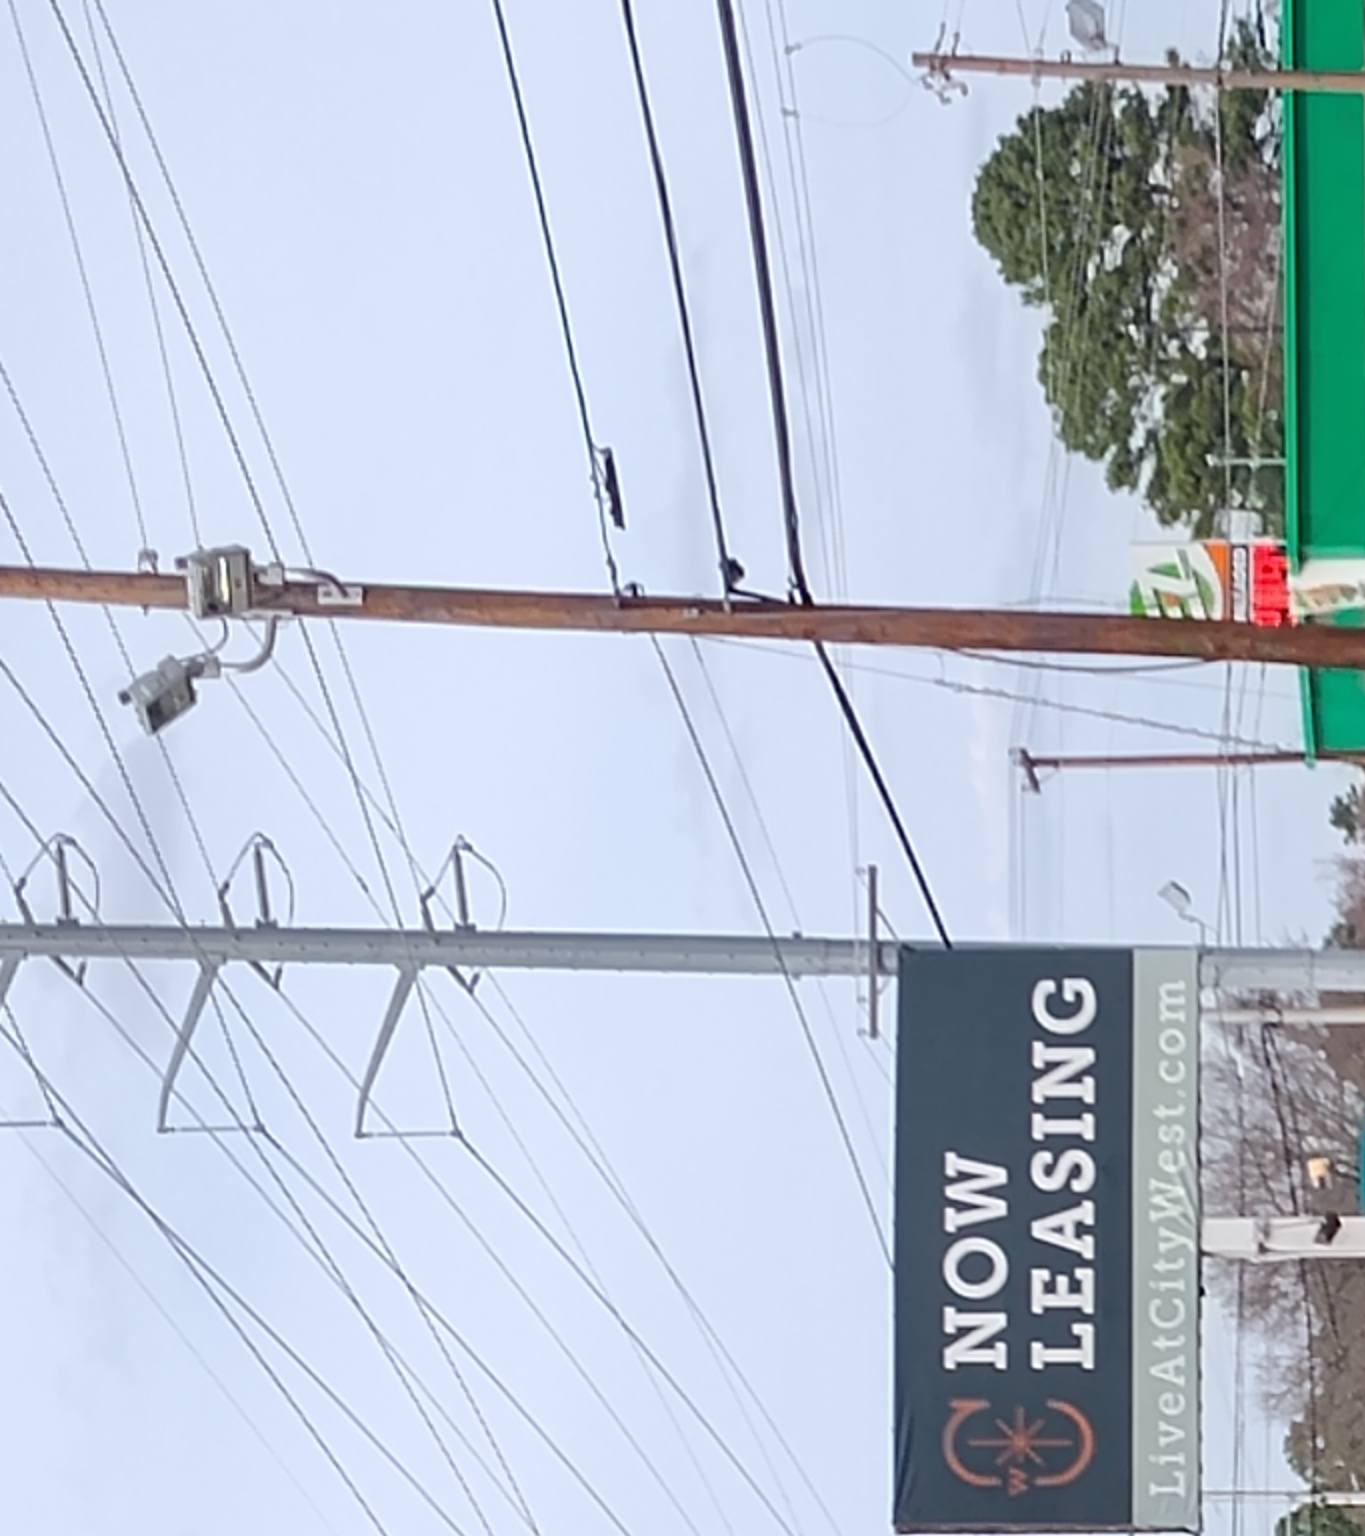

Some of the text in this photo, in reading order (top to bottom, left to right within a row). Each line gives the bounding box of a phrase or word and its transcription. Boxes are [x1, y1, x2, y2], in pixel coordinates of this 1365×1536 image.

[943, 1151, 1009, 1370] NOW
[1030, 976, 1098, 1371] LEASING
[1148, 978, 1193, 1498] LiveAtCityWest.com
